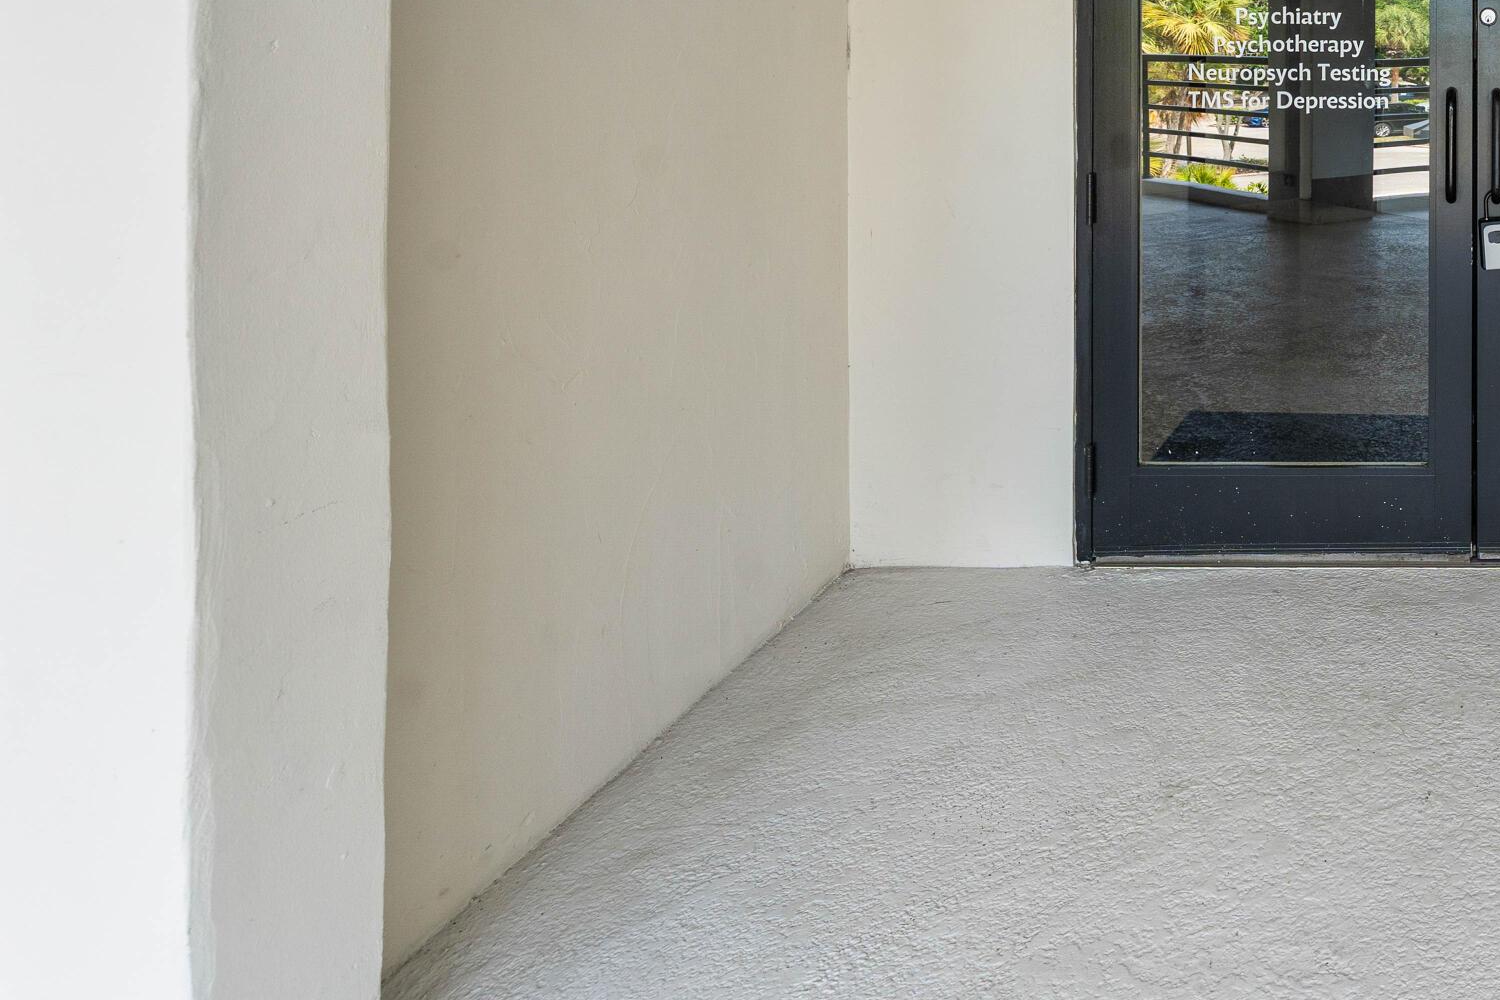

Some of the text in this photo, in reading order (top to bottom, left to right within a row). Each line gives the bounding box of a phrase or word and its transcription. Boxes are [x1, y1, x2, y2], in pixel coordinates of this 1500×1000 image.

[1235, 6, 1342, 30] Psychiatry
[1213, 34, 1364, 58] Psychotherapy
[1188, 63, 1391, 87] Neuropsych Testing
[1188, 90, 1390, 114] TMS for Depression
